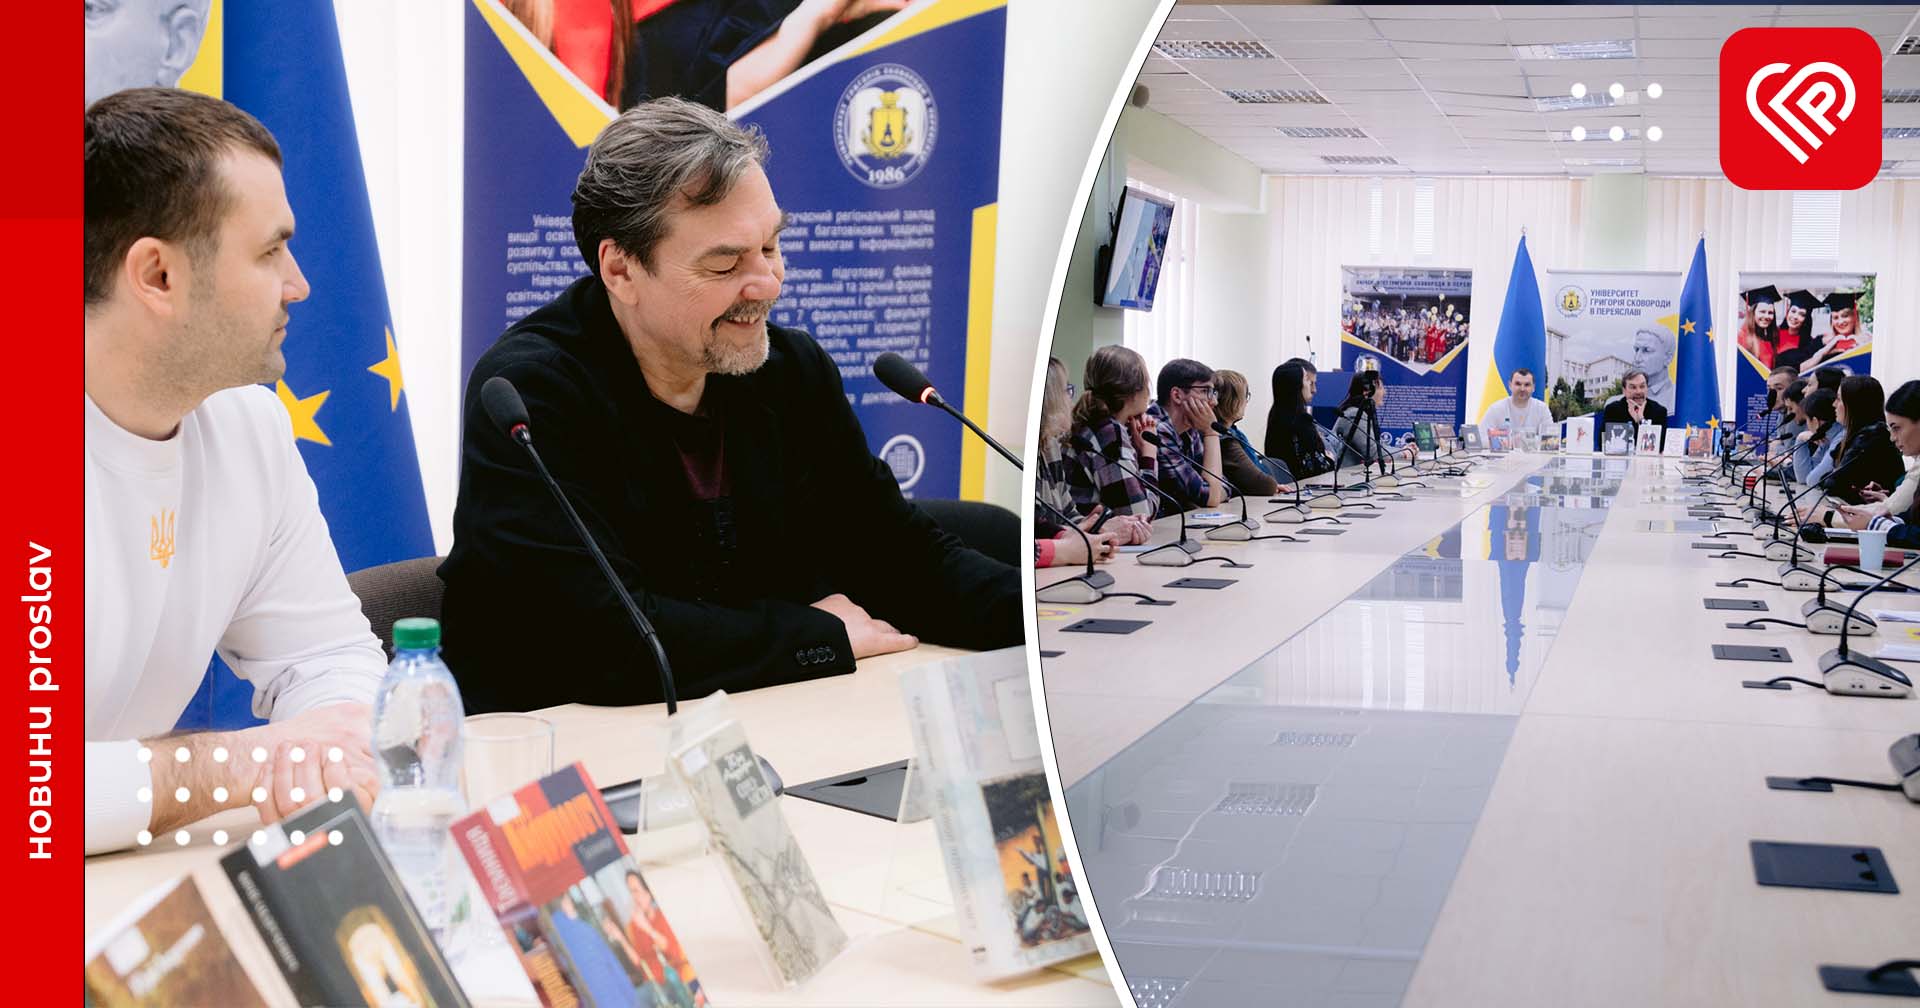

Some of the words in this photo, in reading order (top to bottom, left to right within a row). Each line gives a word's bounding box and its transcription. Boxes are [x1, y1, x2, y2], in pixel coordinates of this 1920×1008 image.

[1590, 289, 1639, 297] УНІВЕРСИТЕТ
[1589, 299, 1625, 307] ГРИГОРІЯ
[1626, 300, 1671, 308] СКОВОРОДИ
[1589, 308, 1595, 316] В
[1596, 308, 1641, 316] ПЕРЕЯСЛАВІ
